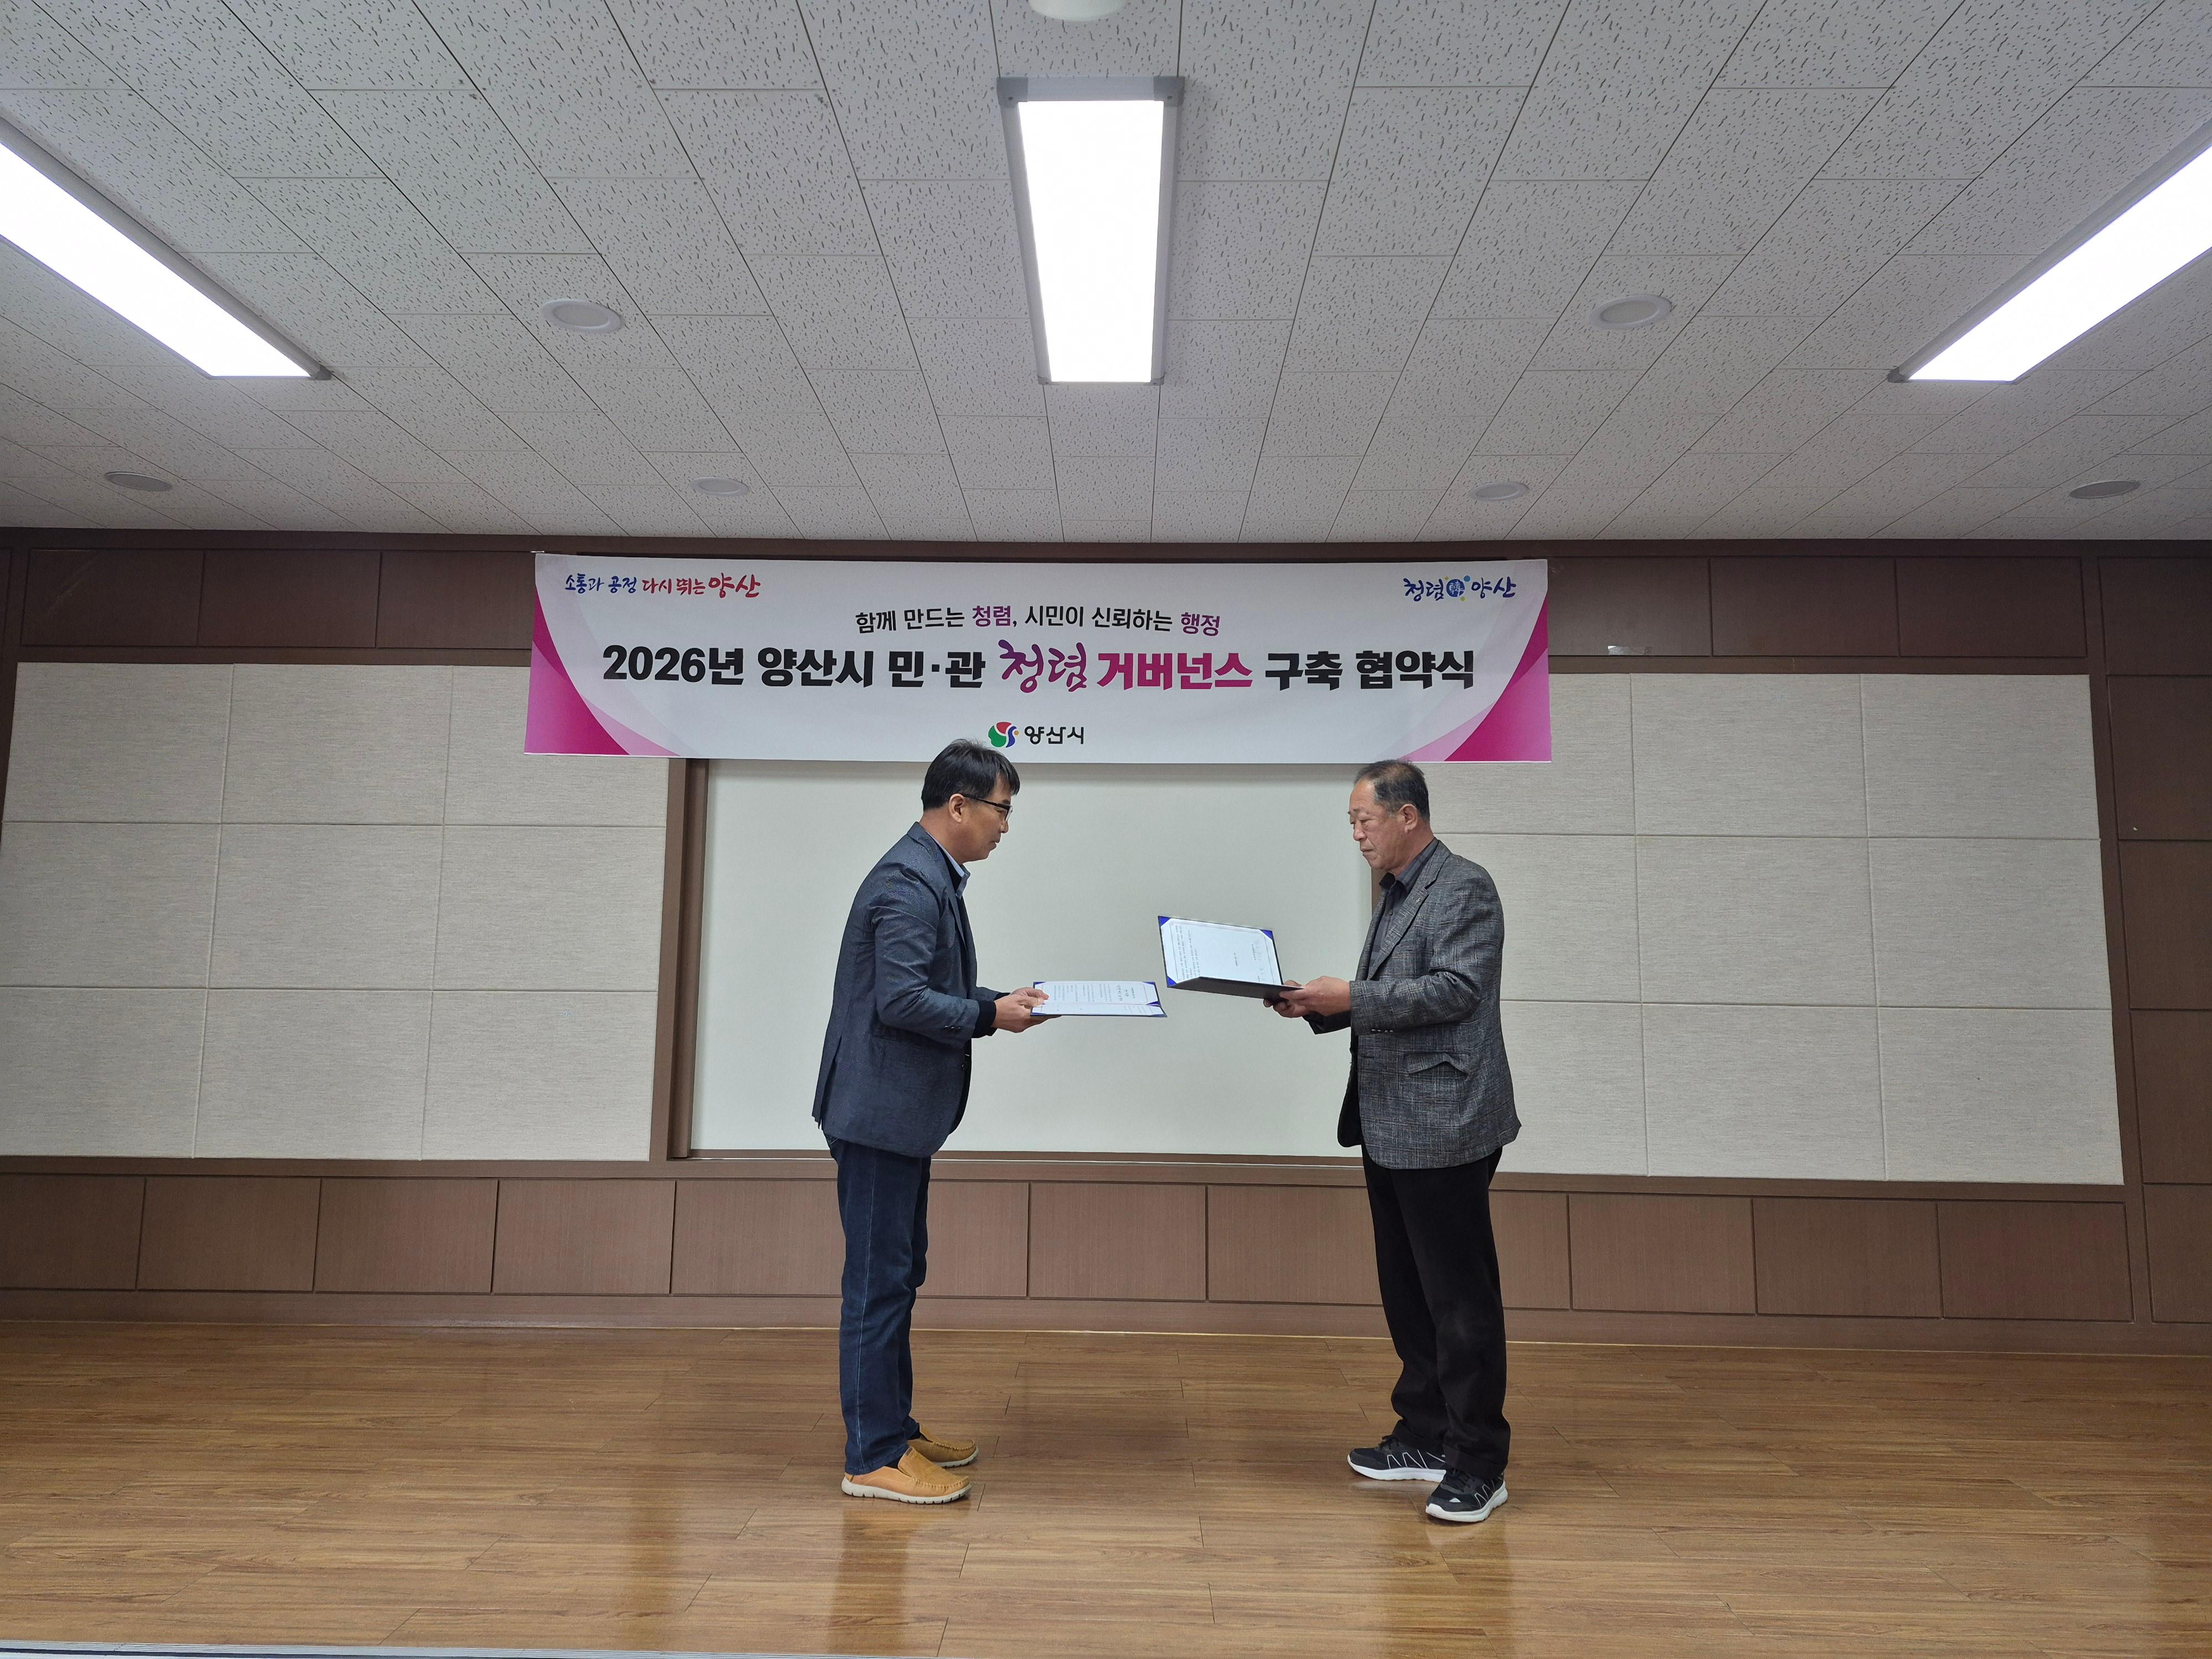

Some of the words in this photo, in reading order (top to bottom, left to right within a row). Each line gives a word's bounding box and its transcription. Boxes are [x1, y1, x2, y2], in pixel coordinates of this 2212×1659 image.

[565, 573, 604, 594] 소통과
[608, 575, 637, 594] 공정
[641, 577, 672, 594] 다시
[676, 578, 706, 596] 뛰는
[708, 572, 761, 598] 양산
[855, 610, 897, 634] 함께
[904, 607, 965, 630] 만드는
[972, 605, 1018, 627] 청렴,
[1025, 605, 1084, 627] 시민이
[1091, 606, 1173, 632] 신뢰하는
[1181, 612, 1220, 637] 행정
[602, 644, 744, 686] 2026년
[757, 647, 874, 688] 양산시
[888, 650, 986, 688] 민·관
[998, 639, 1087, 693] 청렴
[1097, 653, 1253, 691] 거버넌스
[1265, 650, 1343, 691] 구축
[1355, 650, 1474, 690] 협약식
[1024, 726, 1084, 745] 양산시
